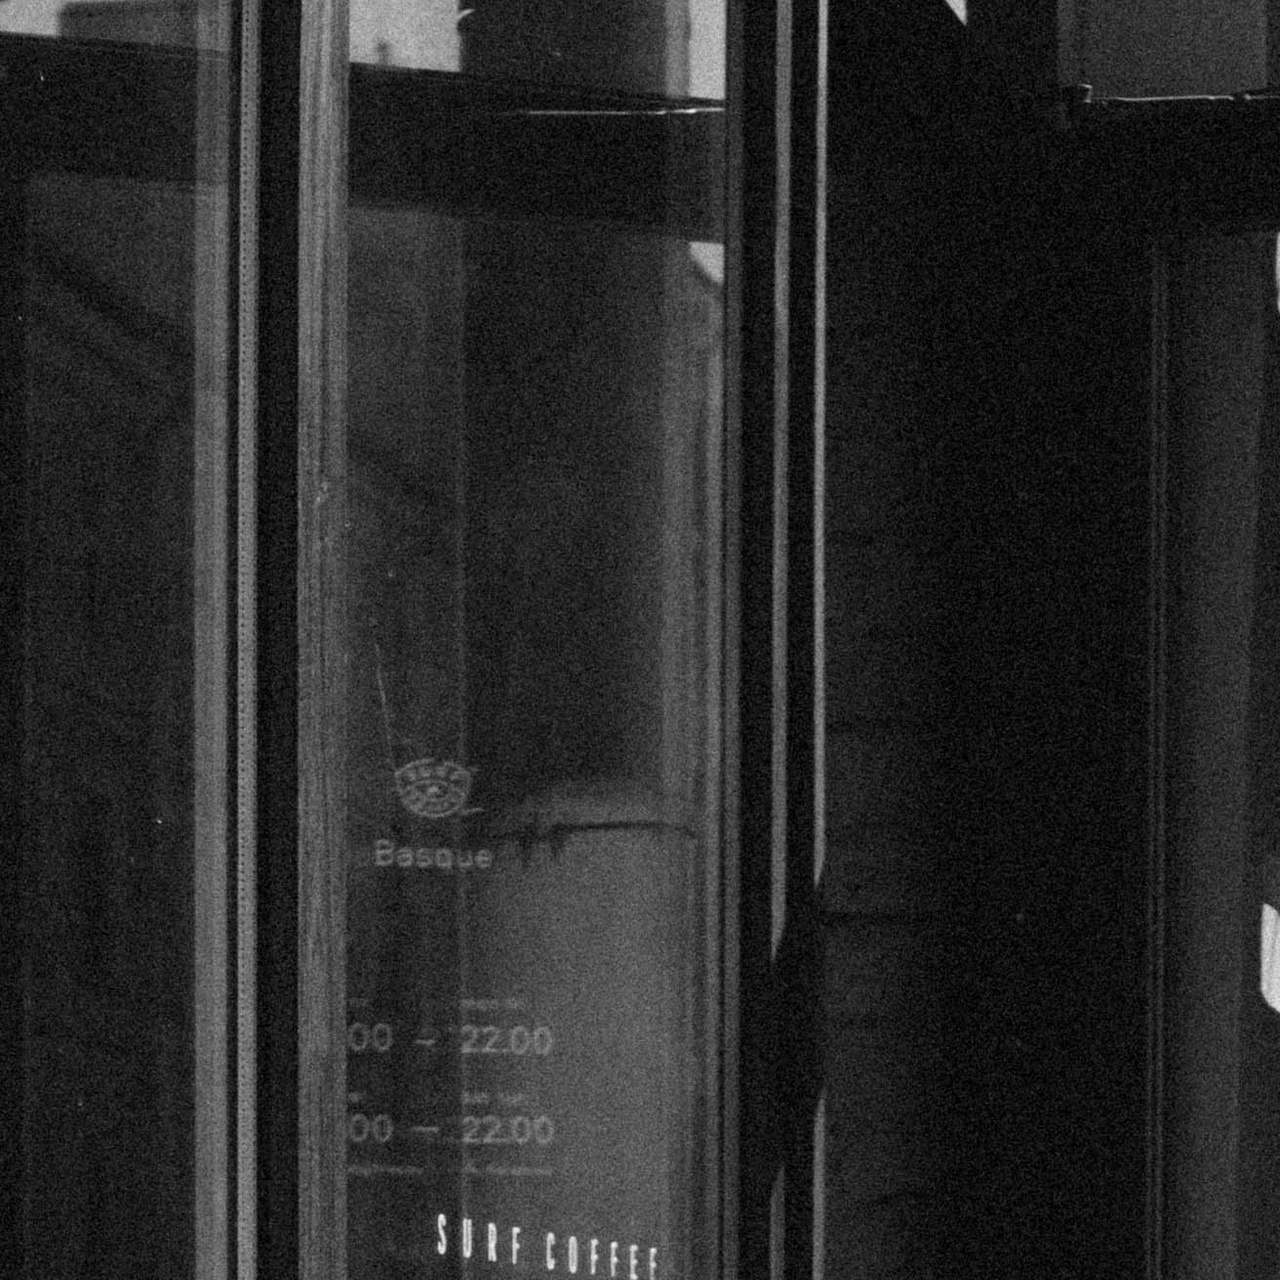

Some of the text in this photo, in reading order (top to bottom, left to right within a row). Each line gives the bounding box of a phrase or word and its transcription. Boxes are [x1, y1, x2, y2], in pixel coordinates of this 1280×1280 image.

[373, 838, 494, 870] Basque
[348, 1022, 394, 1053] 00
[461, 1025, 554, 1056] 22.00
[348, 1114, 395, 1143] 00
[462, 1114, 556, 1146] 22.00
[436, 1213, 521, 1264] SURF
